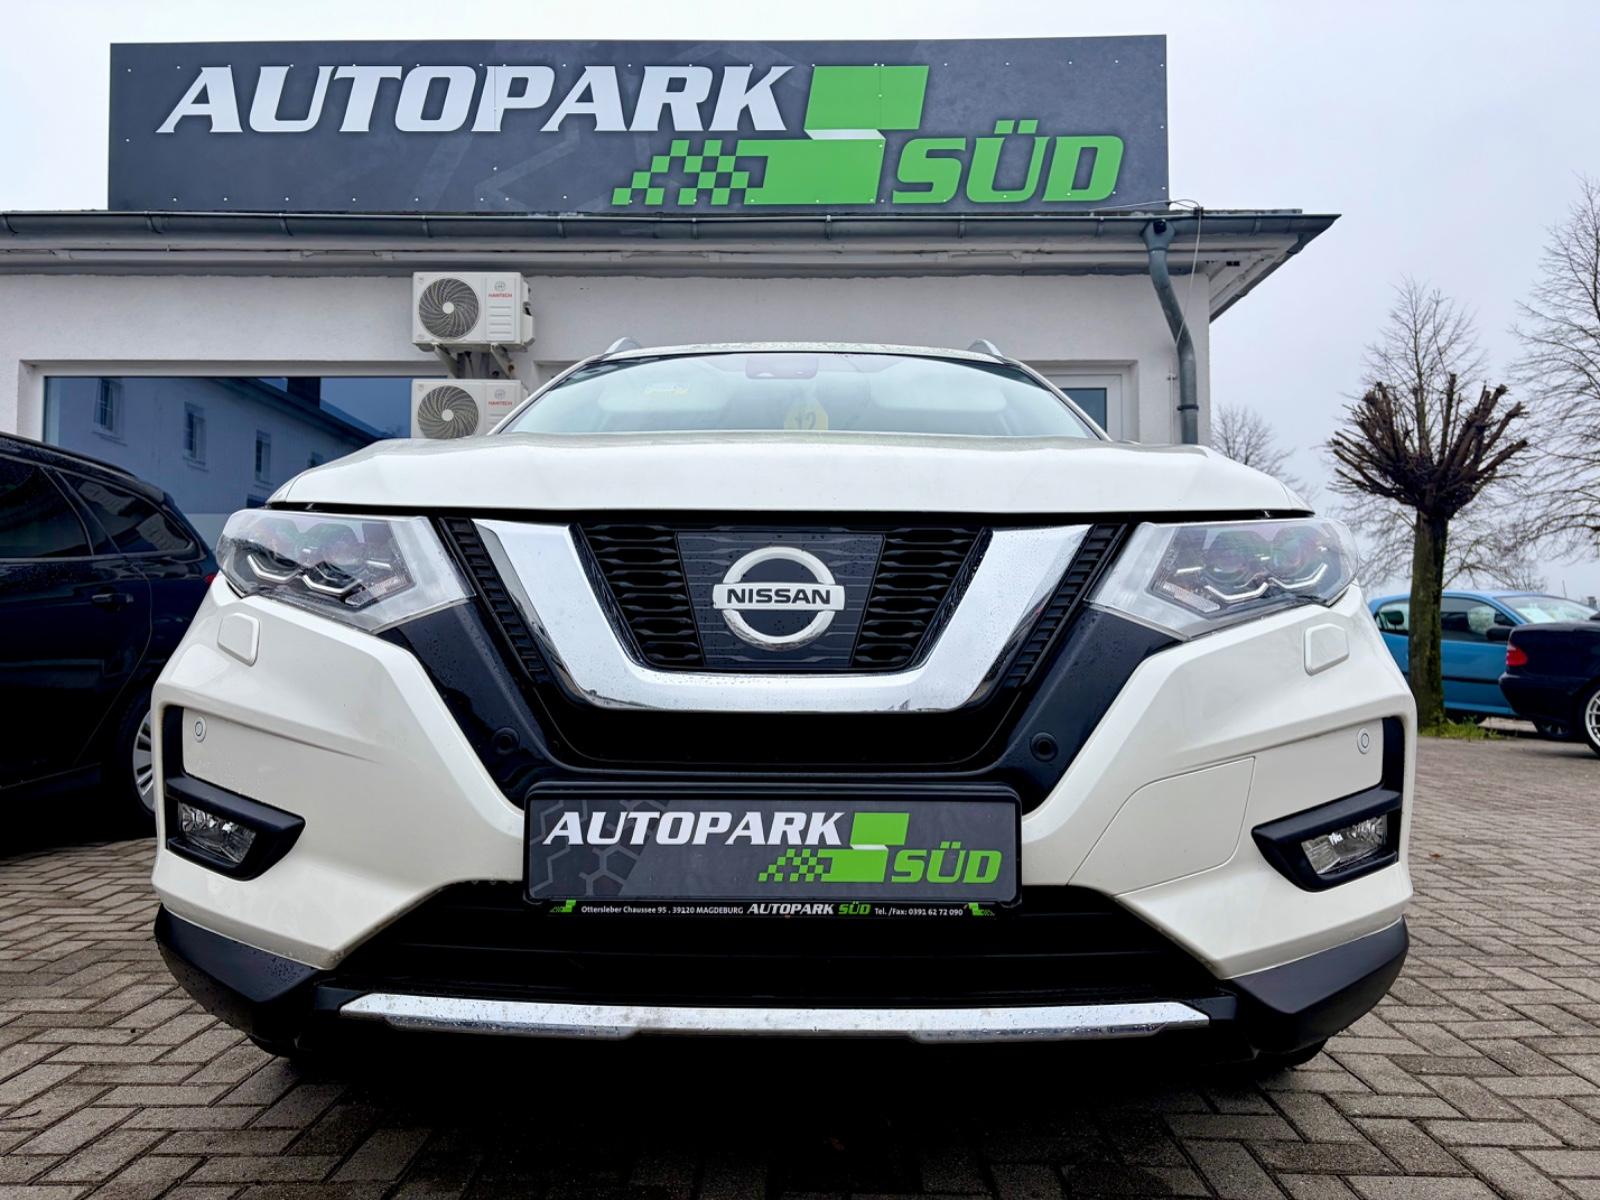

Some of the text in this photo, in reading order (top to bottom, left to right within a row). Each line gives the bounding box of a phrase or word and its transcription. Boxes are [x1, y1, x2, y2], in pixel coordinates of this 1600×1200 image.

[157, 65, 793, 134] AUTOPARK
[892, 119, 1124, 205] SÜD
[727, 588, 831, 605] NISSAN
[543, 811, 843, 846] AUTOPARK
[891, 841, 1003, 884] SÜD
[581, 905, 622, 913] Ottersleber
[623, 905, 656, 914] Chaussee
[696, 906, 744, 914] MAGDEBURG
[747, 903, 834, 915] AUTOPARK
[838, 901, 871, 915] SÜD
[908, 907, 927, 916] 0391
[928, 907, 938, 916] 62
[939, 907, 948, 916] 72
[949, 907, 963, 916] 090
